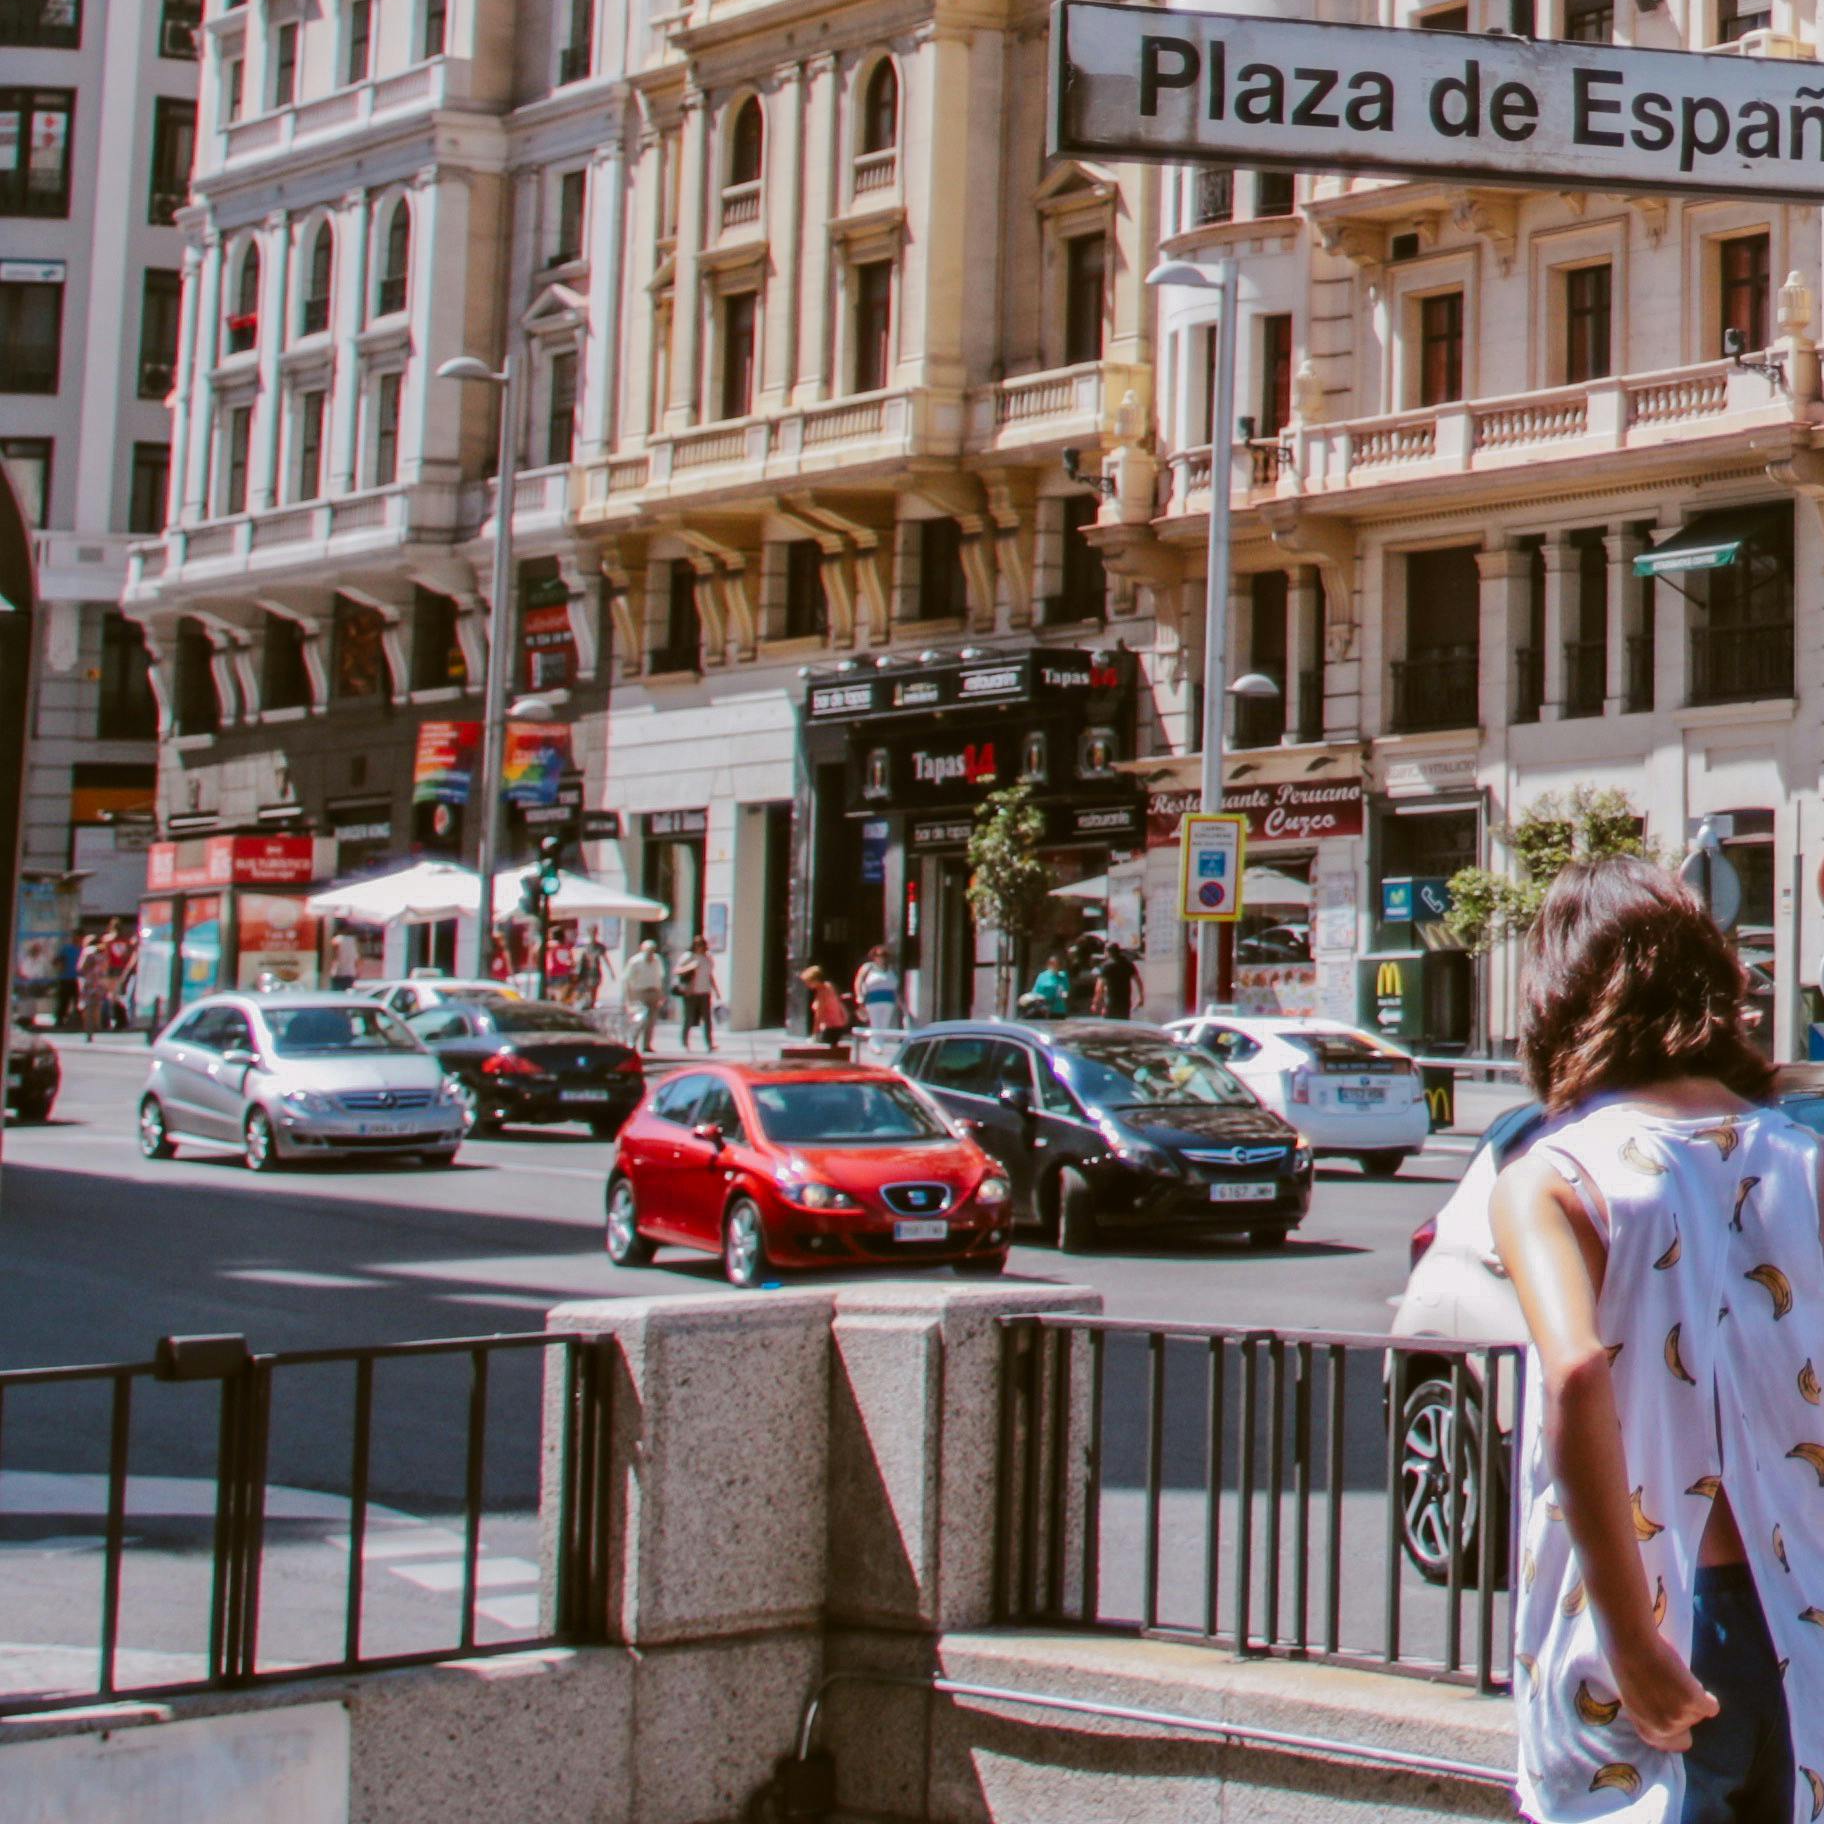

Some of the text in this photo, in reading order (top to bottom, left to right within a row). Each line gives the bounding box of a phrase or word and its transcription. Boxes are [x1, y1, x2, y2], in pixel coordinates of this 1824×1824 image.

[1139, 34, 1396, 132] Plaza
[1428, 59, 1539, 141] de
[1274, 782, 1362, 805] Peruano
[1264, 807, 1337, 838] Cuzco
